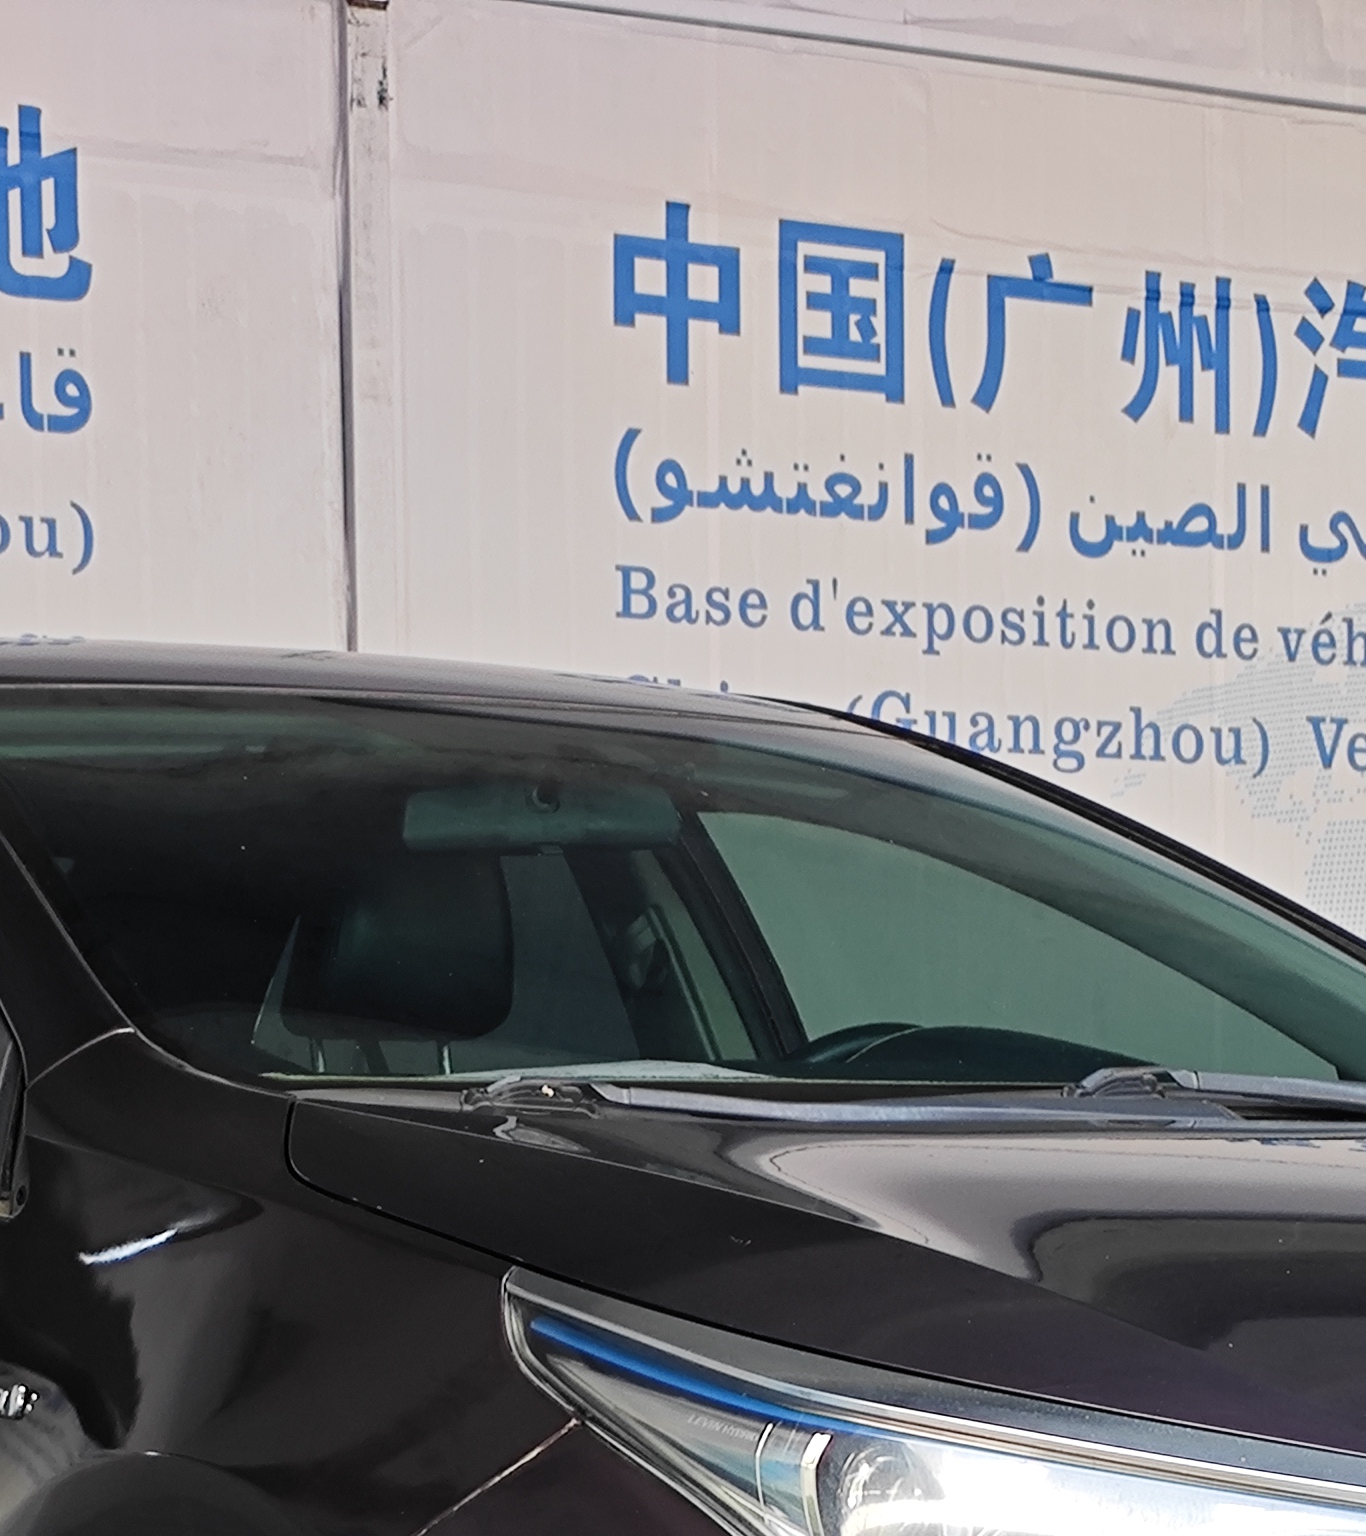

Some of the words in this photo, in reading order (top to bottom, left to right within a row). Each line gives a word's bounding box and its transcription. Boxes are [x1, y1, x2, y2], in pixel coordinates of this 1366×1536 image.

[1068, 482, 1271, 559] الصين
[614, 564, 768, 627] Base
[790, 577, 1177, 655] d'exposition
[1195, 609, 1260, 661] de
